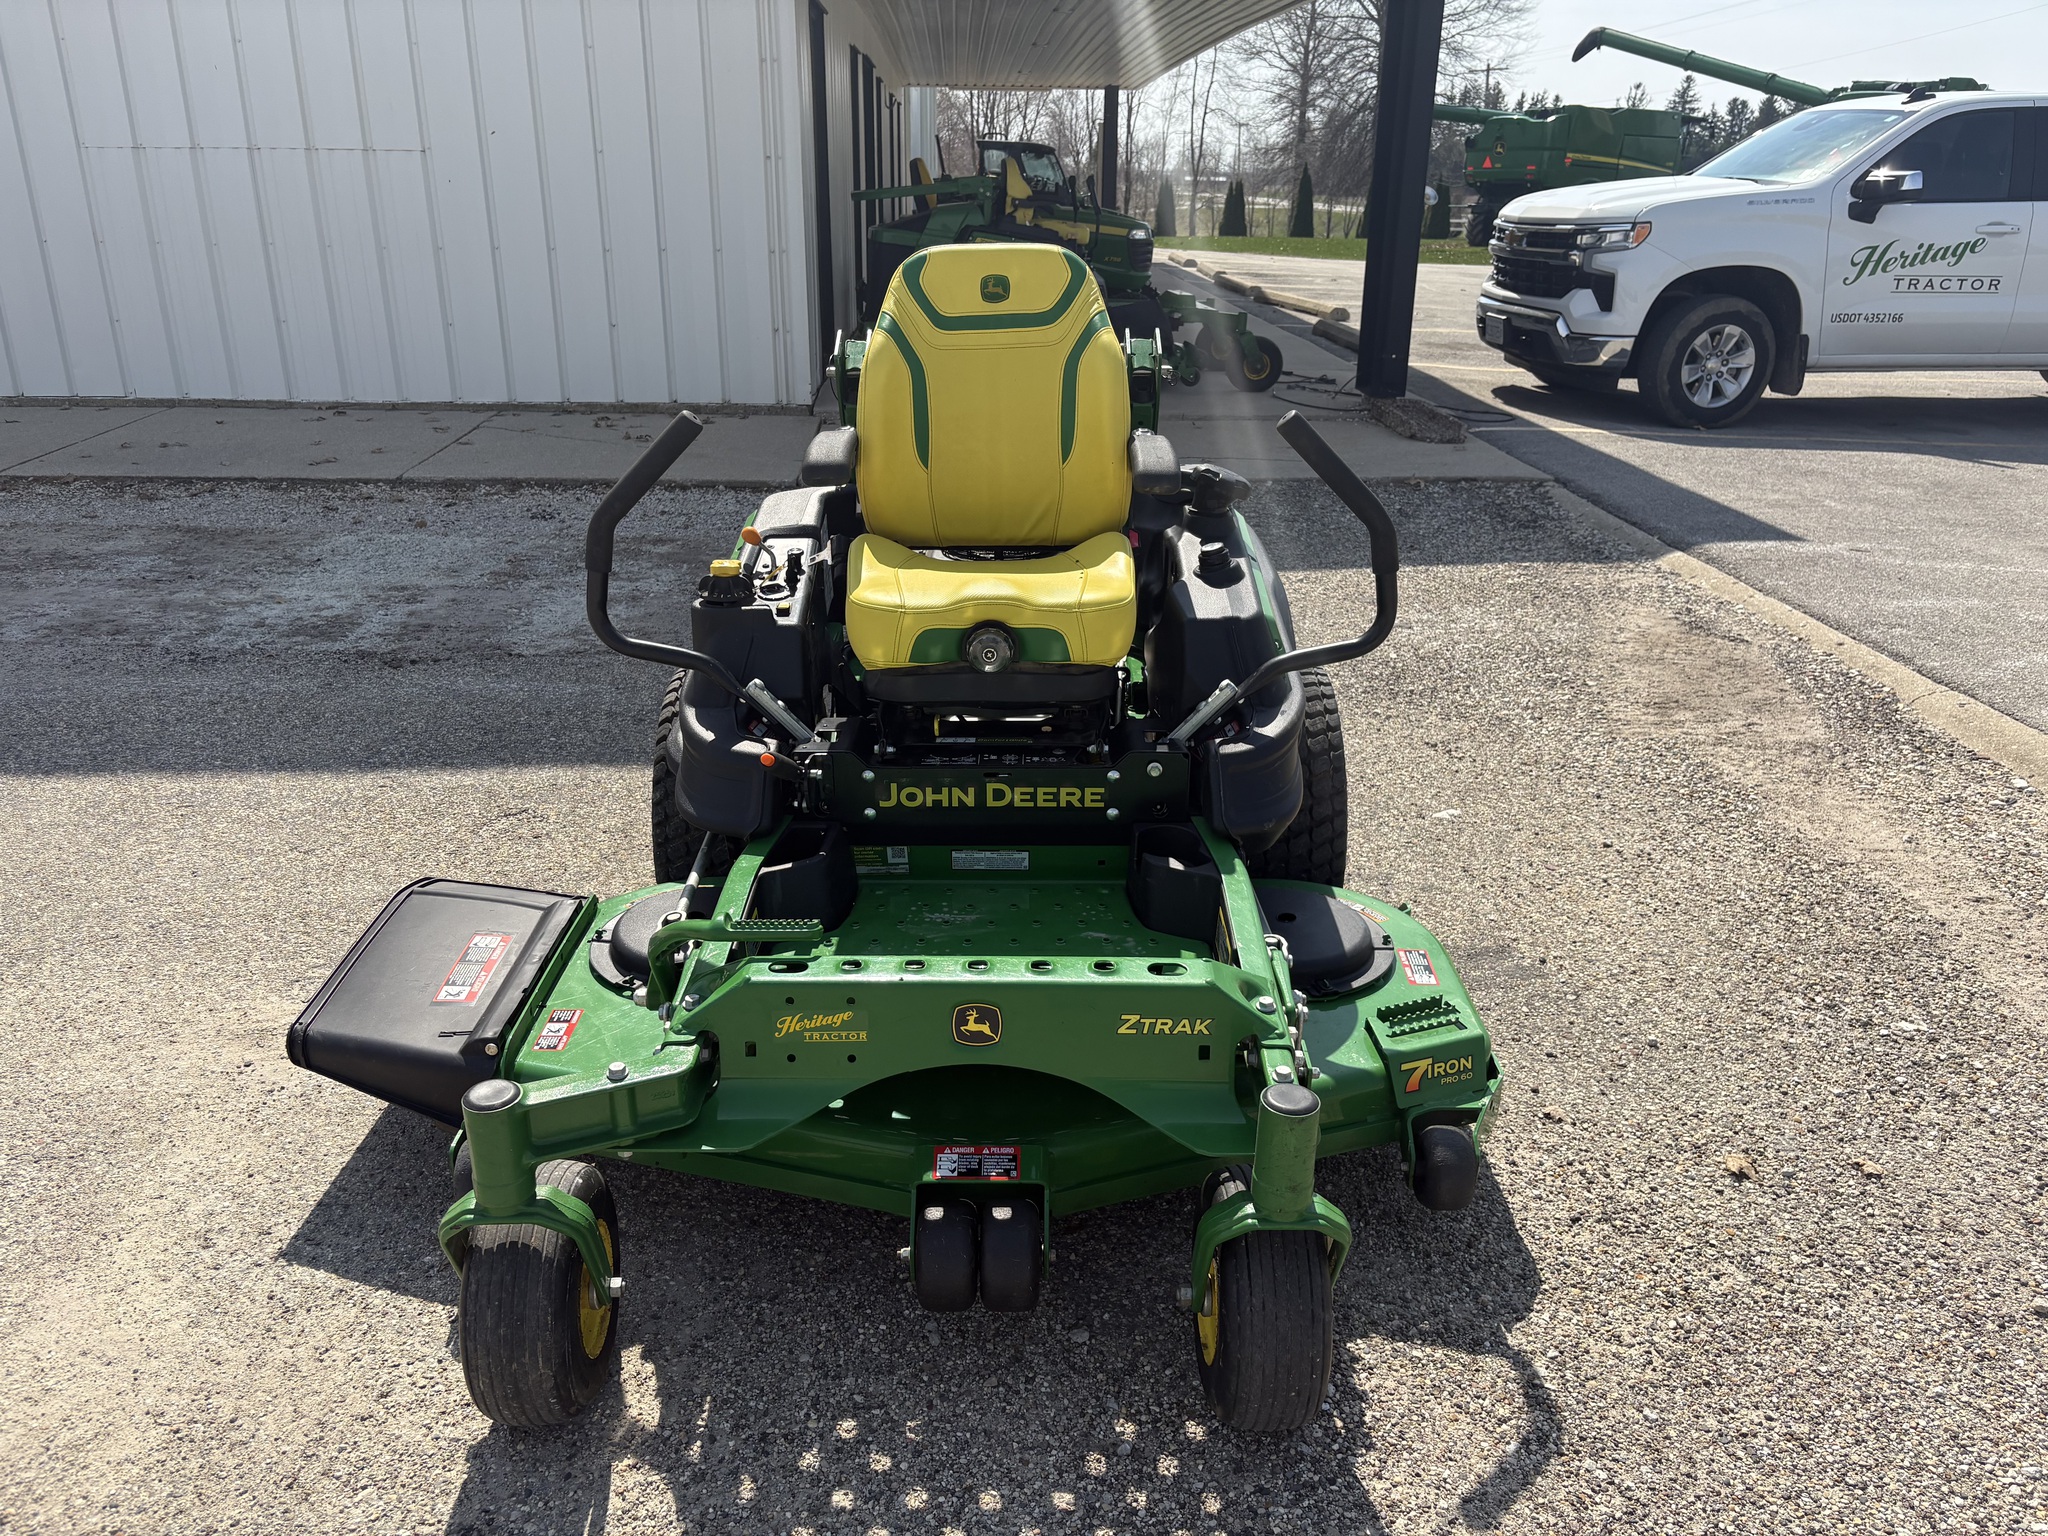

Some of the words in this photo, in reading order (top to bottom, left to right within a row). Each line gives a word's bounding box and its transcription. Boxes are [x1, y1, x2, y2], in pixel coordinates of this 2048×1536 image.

[1842, 237, 1989, 286] Heritage
[1893, 278, 2001, 291] TRACTOR
[1830, 313, 1863, 324] USDOT
[1863, 312, 1904, 324] 4352166
[879, 782, 975, 808] JOHN
[986, 782, 1105, 808] DEERE
[774, 1011, 854, 1038] Heritage
[1117, 1014, 1214, 1035] ZTRAK
[803, 1032, 867, 1041] TRACTOR
[1441, 1075, 1459, 1086] PRO
[1460, 1071, 1473, 1081] 60
